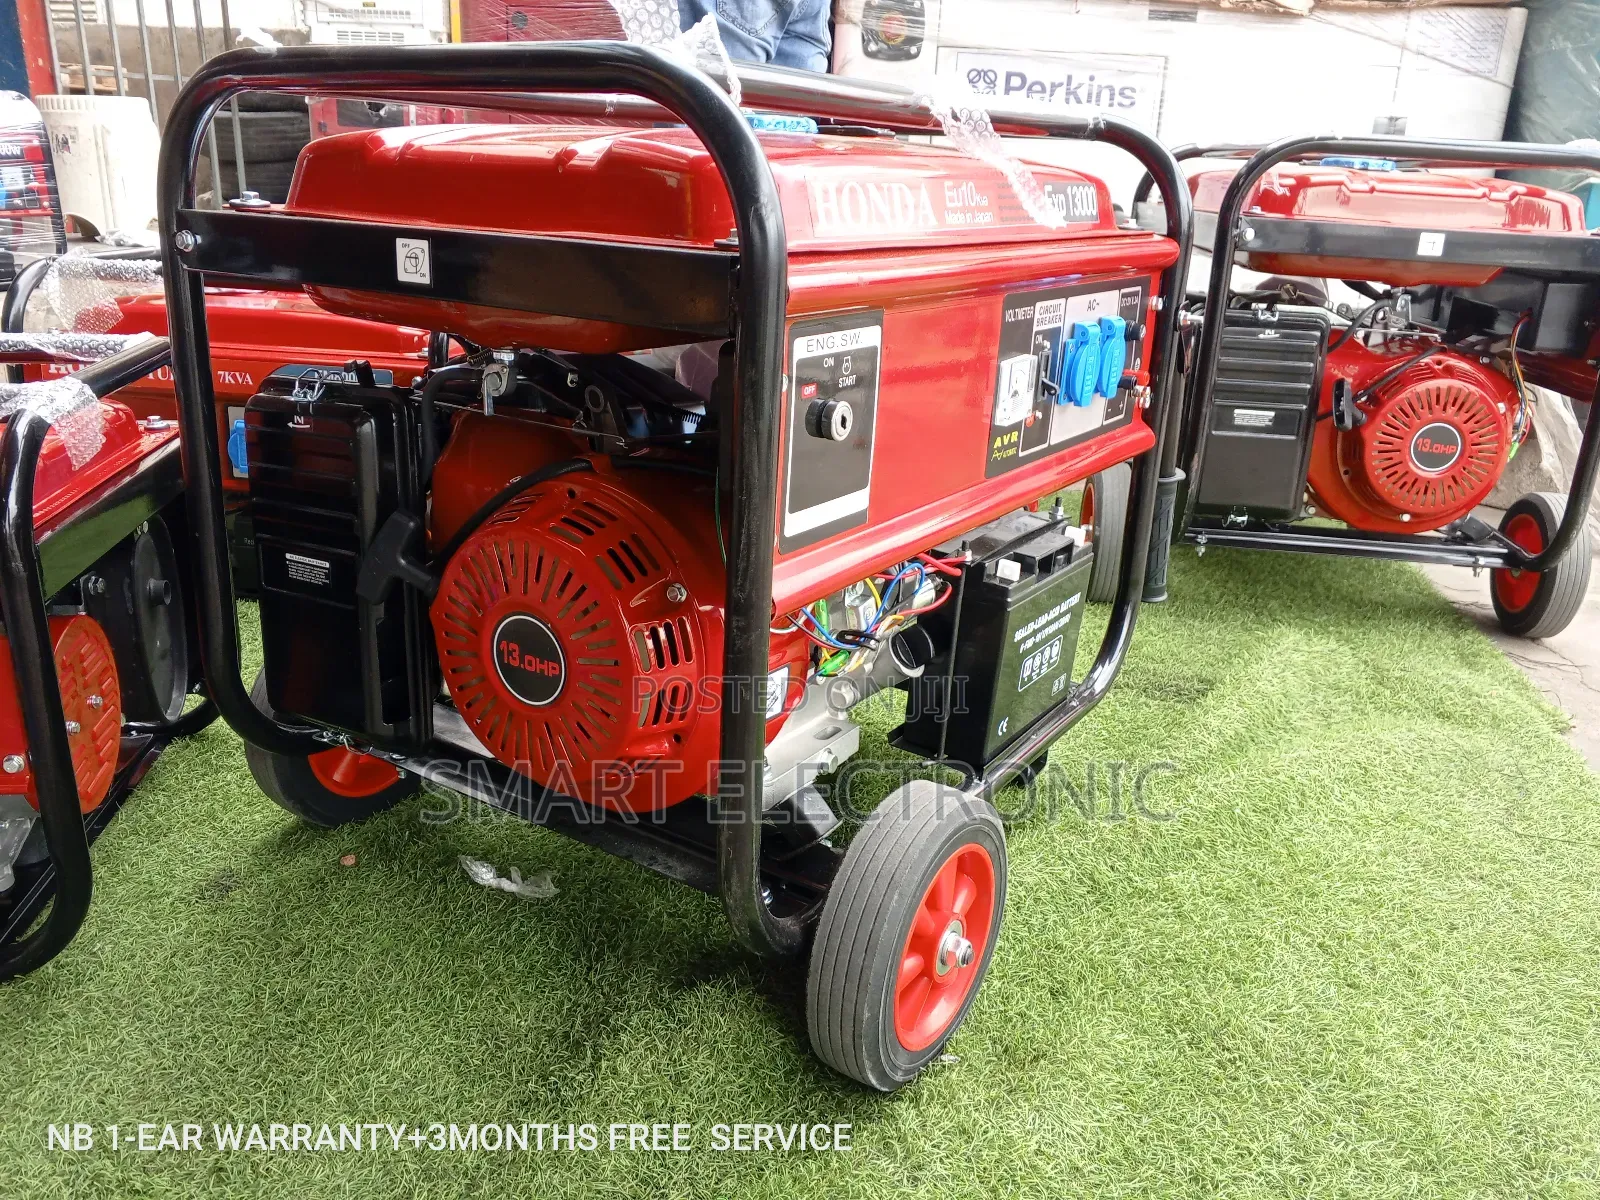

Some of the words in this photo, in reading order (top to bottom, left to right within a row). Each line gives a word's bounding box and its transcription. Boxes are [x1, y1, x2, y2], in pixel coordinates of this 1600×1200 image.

[1003, 70, 1137, 109] Perkins
[811, 180, 939, 228] HONDA
[1066, 185, 1097, 217] 13000
[944, 210, 966, 224] Made
[973, 210, 994, 225] Japan
[1005, 305, 1035, 323] VOLTMETER
[1038, 303, 1062, 317] CIRCUIT
[1036, 314, 1063, 327] BREAKER
[823, 356, 835, 368] ON
[217, 370, 254, 386] 7KVA
[838, 374, 857, 388] START
[803, 384, 816, 396] OFF
[993, 430, 1019, 449] AVR
[1416, 437, 1458, 455] 13.0HP
[500, 640, 560, 677] 13.0HP
